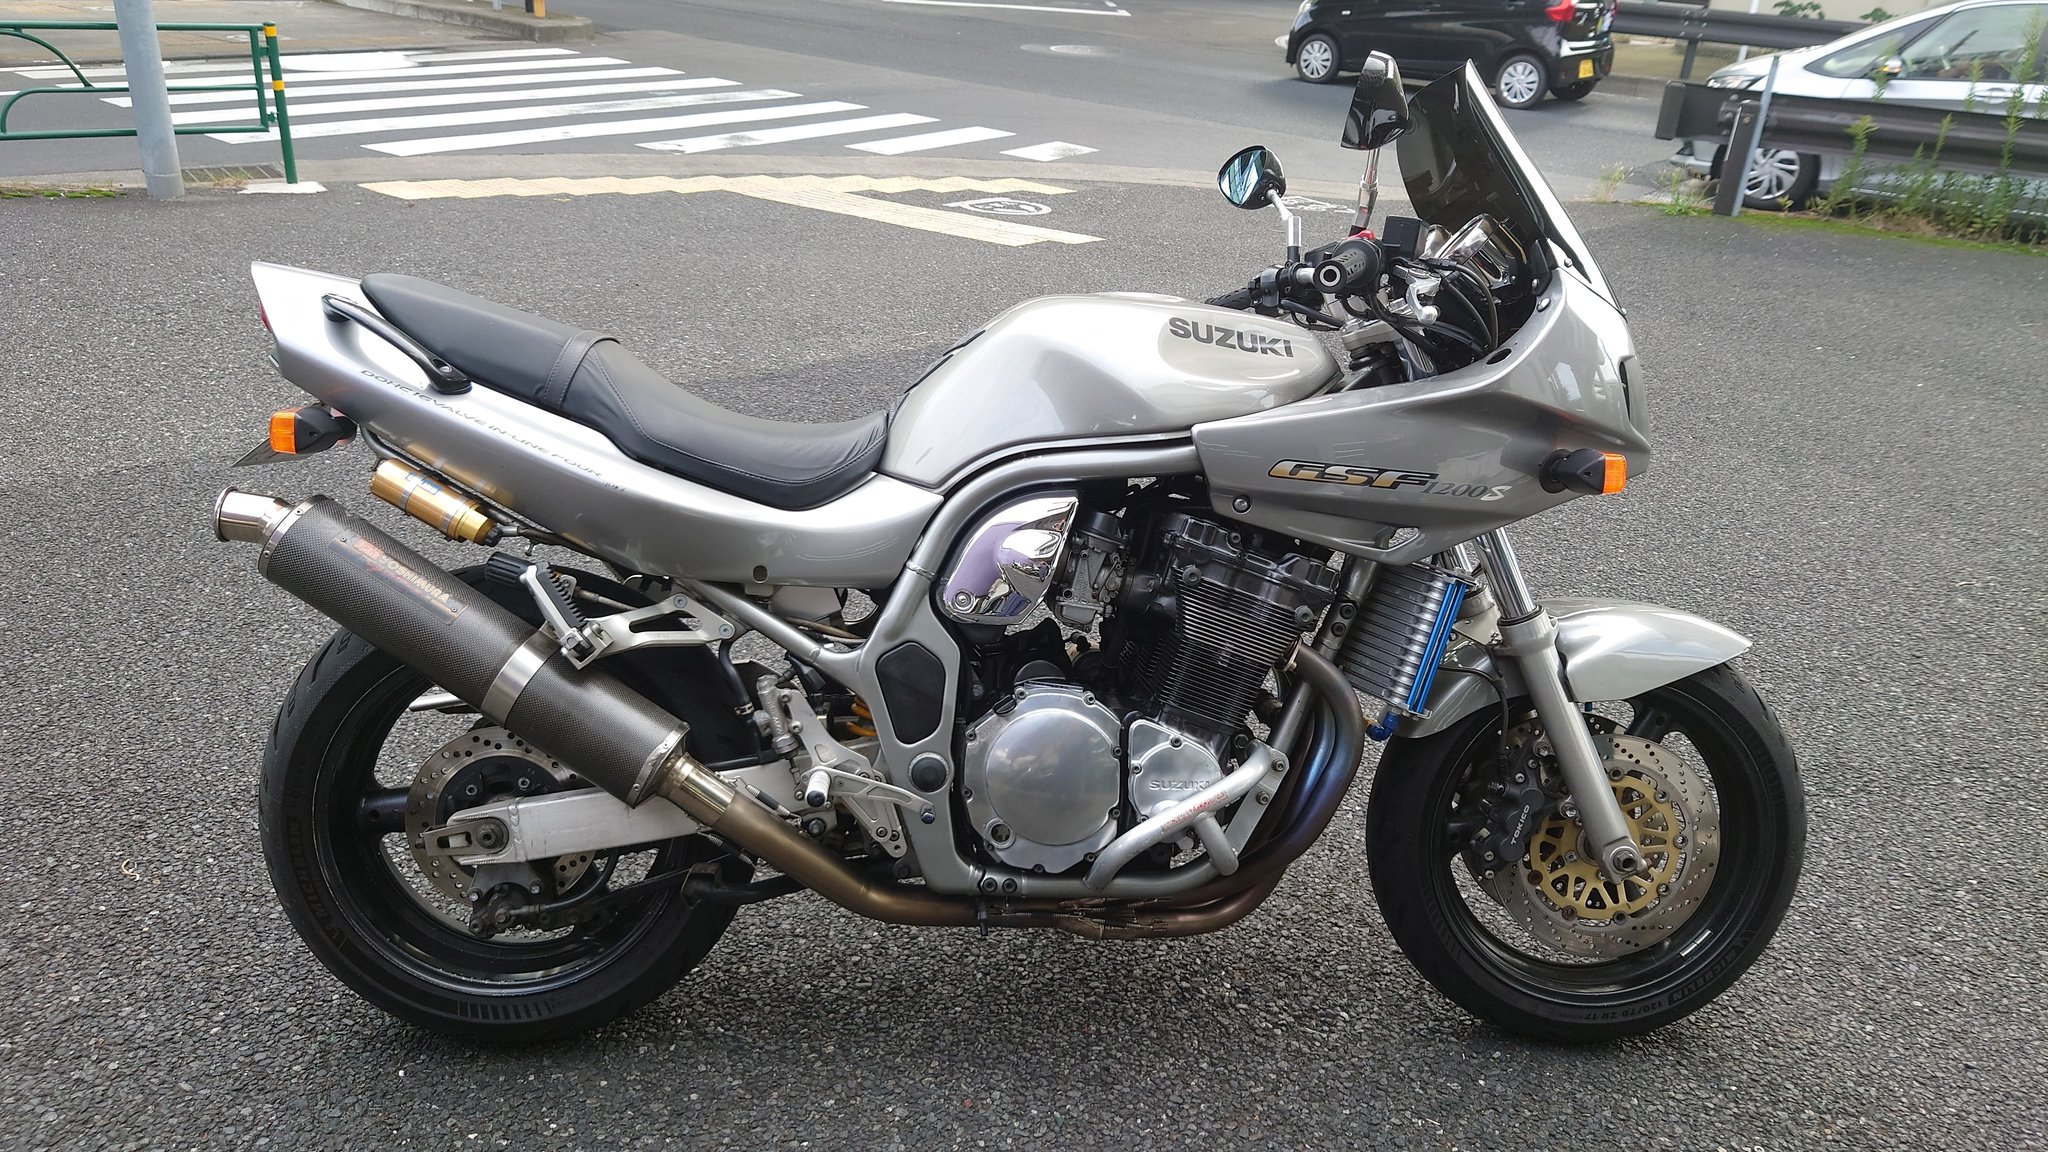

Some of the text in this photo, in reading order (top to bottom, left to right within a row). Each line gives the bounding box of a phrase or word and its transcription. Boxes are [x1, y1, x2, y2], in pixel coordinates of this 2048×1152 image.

[1169, 317, 1294, 358] SUZUKI
[360, 369, 412, 393] DOHC
[551, 452, 603, 477] FOUR
[1268, 458, 1512, 501] GSF 1200S
[378, 554, 450, 604] YOSHIMURA
[1149, 780, 1210, 791] SUZUKI
[1510, 804, 1530, 845] TOKICO
[1672, 948, 1738, 1001] MICHELIN
